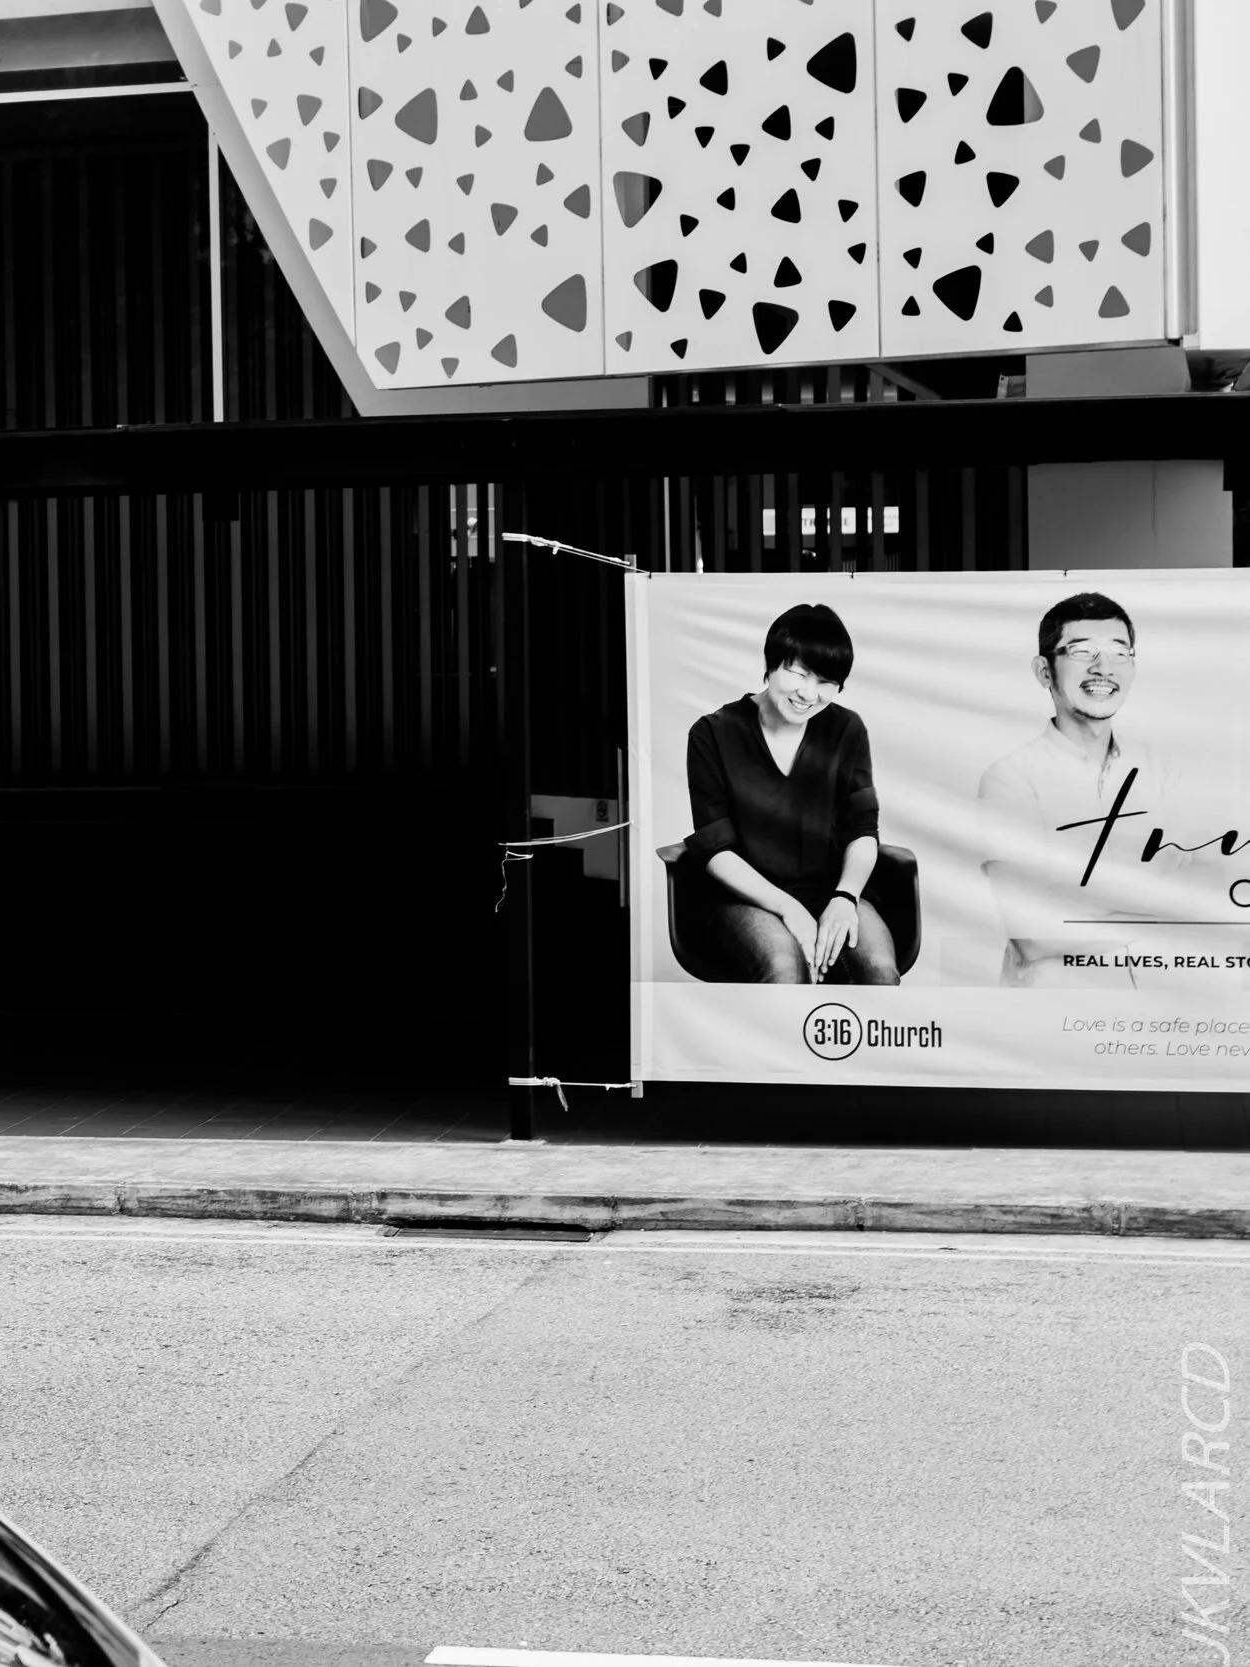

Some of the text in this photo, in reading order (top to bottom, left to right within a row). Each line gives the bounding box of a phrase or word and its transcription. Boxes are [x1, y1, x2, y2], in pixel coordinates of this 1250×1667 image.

[1063, 955, 1109, 967] REAL
[1114, 956, 1168, 970] LIVES,
[1174, 956, 1220, 968] REAL
[814, 1018, 942, 1048] 3:16 Church
[1062, 1016, 1250, 1036] Love is a safe place
[1094, 1040, 1159, 1055] others.
[1166, 1041, 1211, 1056] Love
